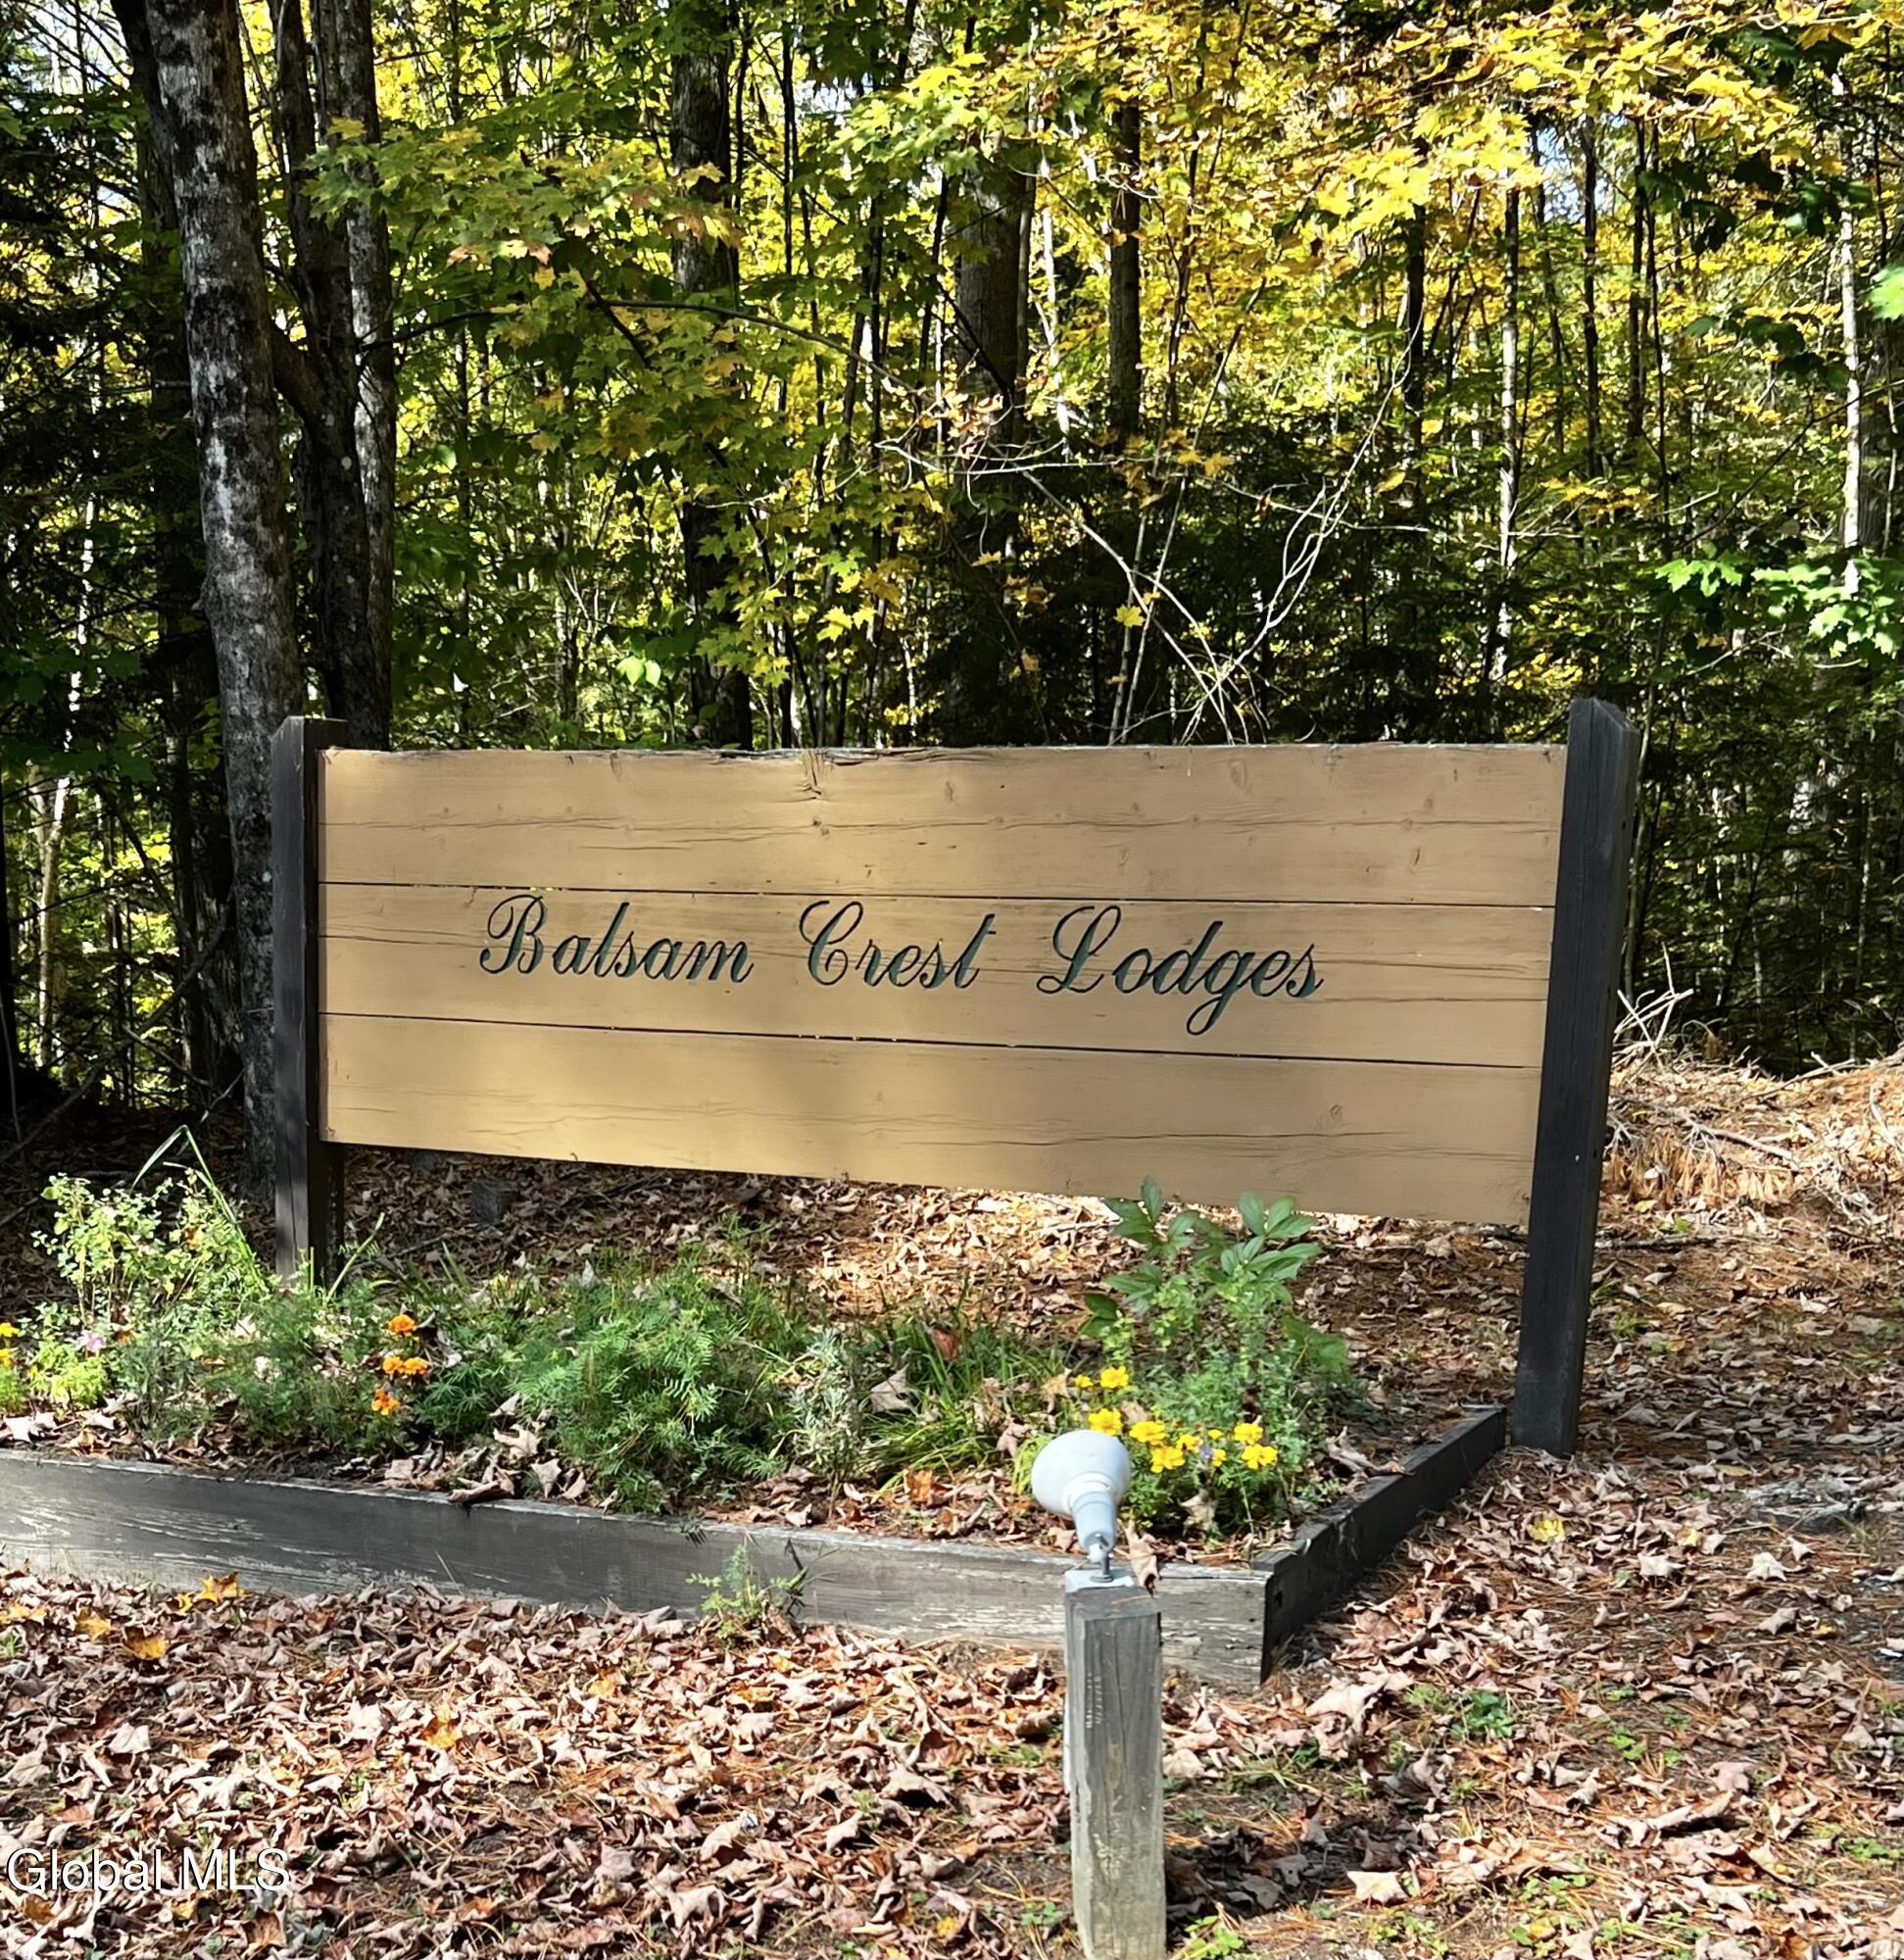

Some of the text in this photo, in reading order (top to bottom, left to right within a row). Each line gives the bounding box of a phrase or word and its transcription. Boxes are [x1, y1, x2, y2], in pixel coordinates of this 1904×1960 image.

[479, 894, 1324, 1036] Balsam Crest Lodges
